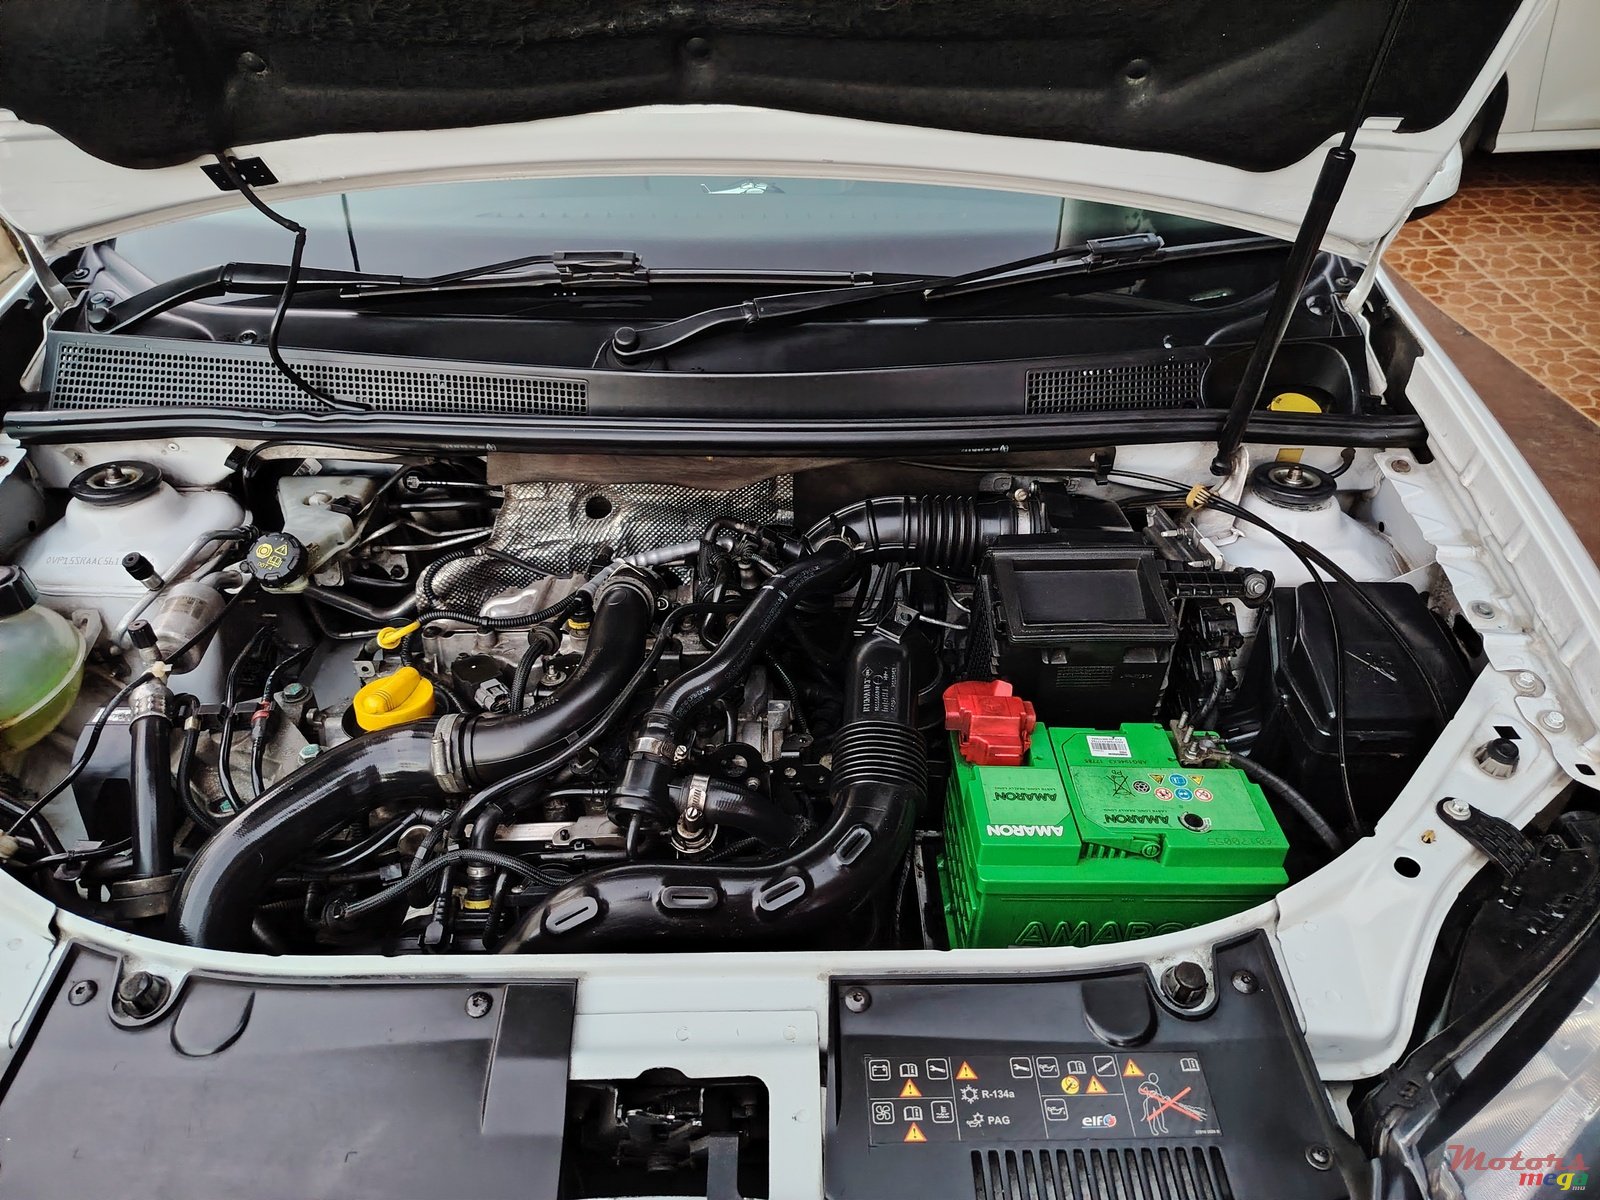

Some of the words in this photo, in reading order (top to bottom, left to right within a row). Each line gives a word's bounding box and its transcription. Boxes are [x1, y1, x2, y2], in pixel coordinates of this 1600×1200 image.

[994, 791, 1057, 802] AMARON
[1104, 814, 1169, 825] AMARON
[986, 824, 1064, 837] AMARON
[981, 1089, 1016, 1100] R-134a
[987, 1115, 1011, 1126] PAG
[1082, 1115, 1105, 1127] elf
